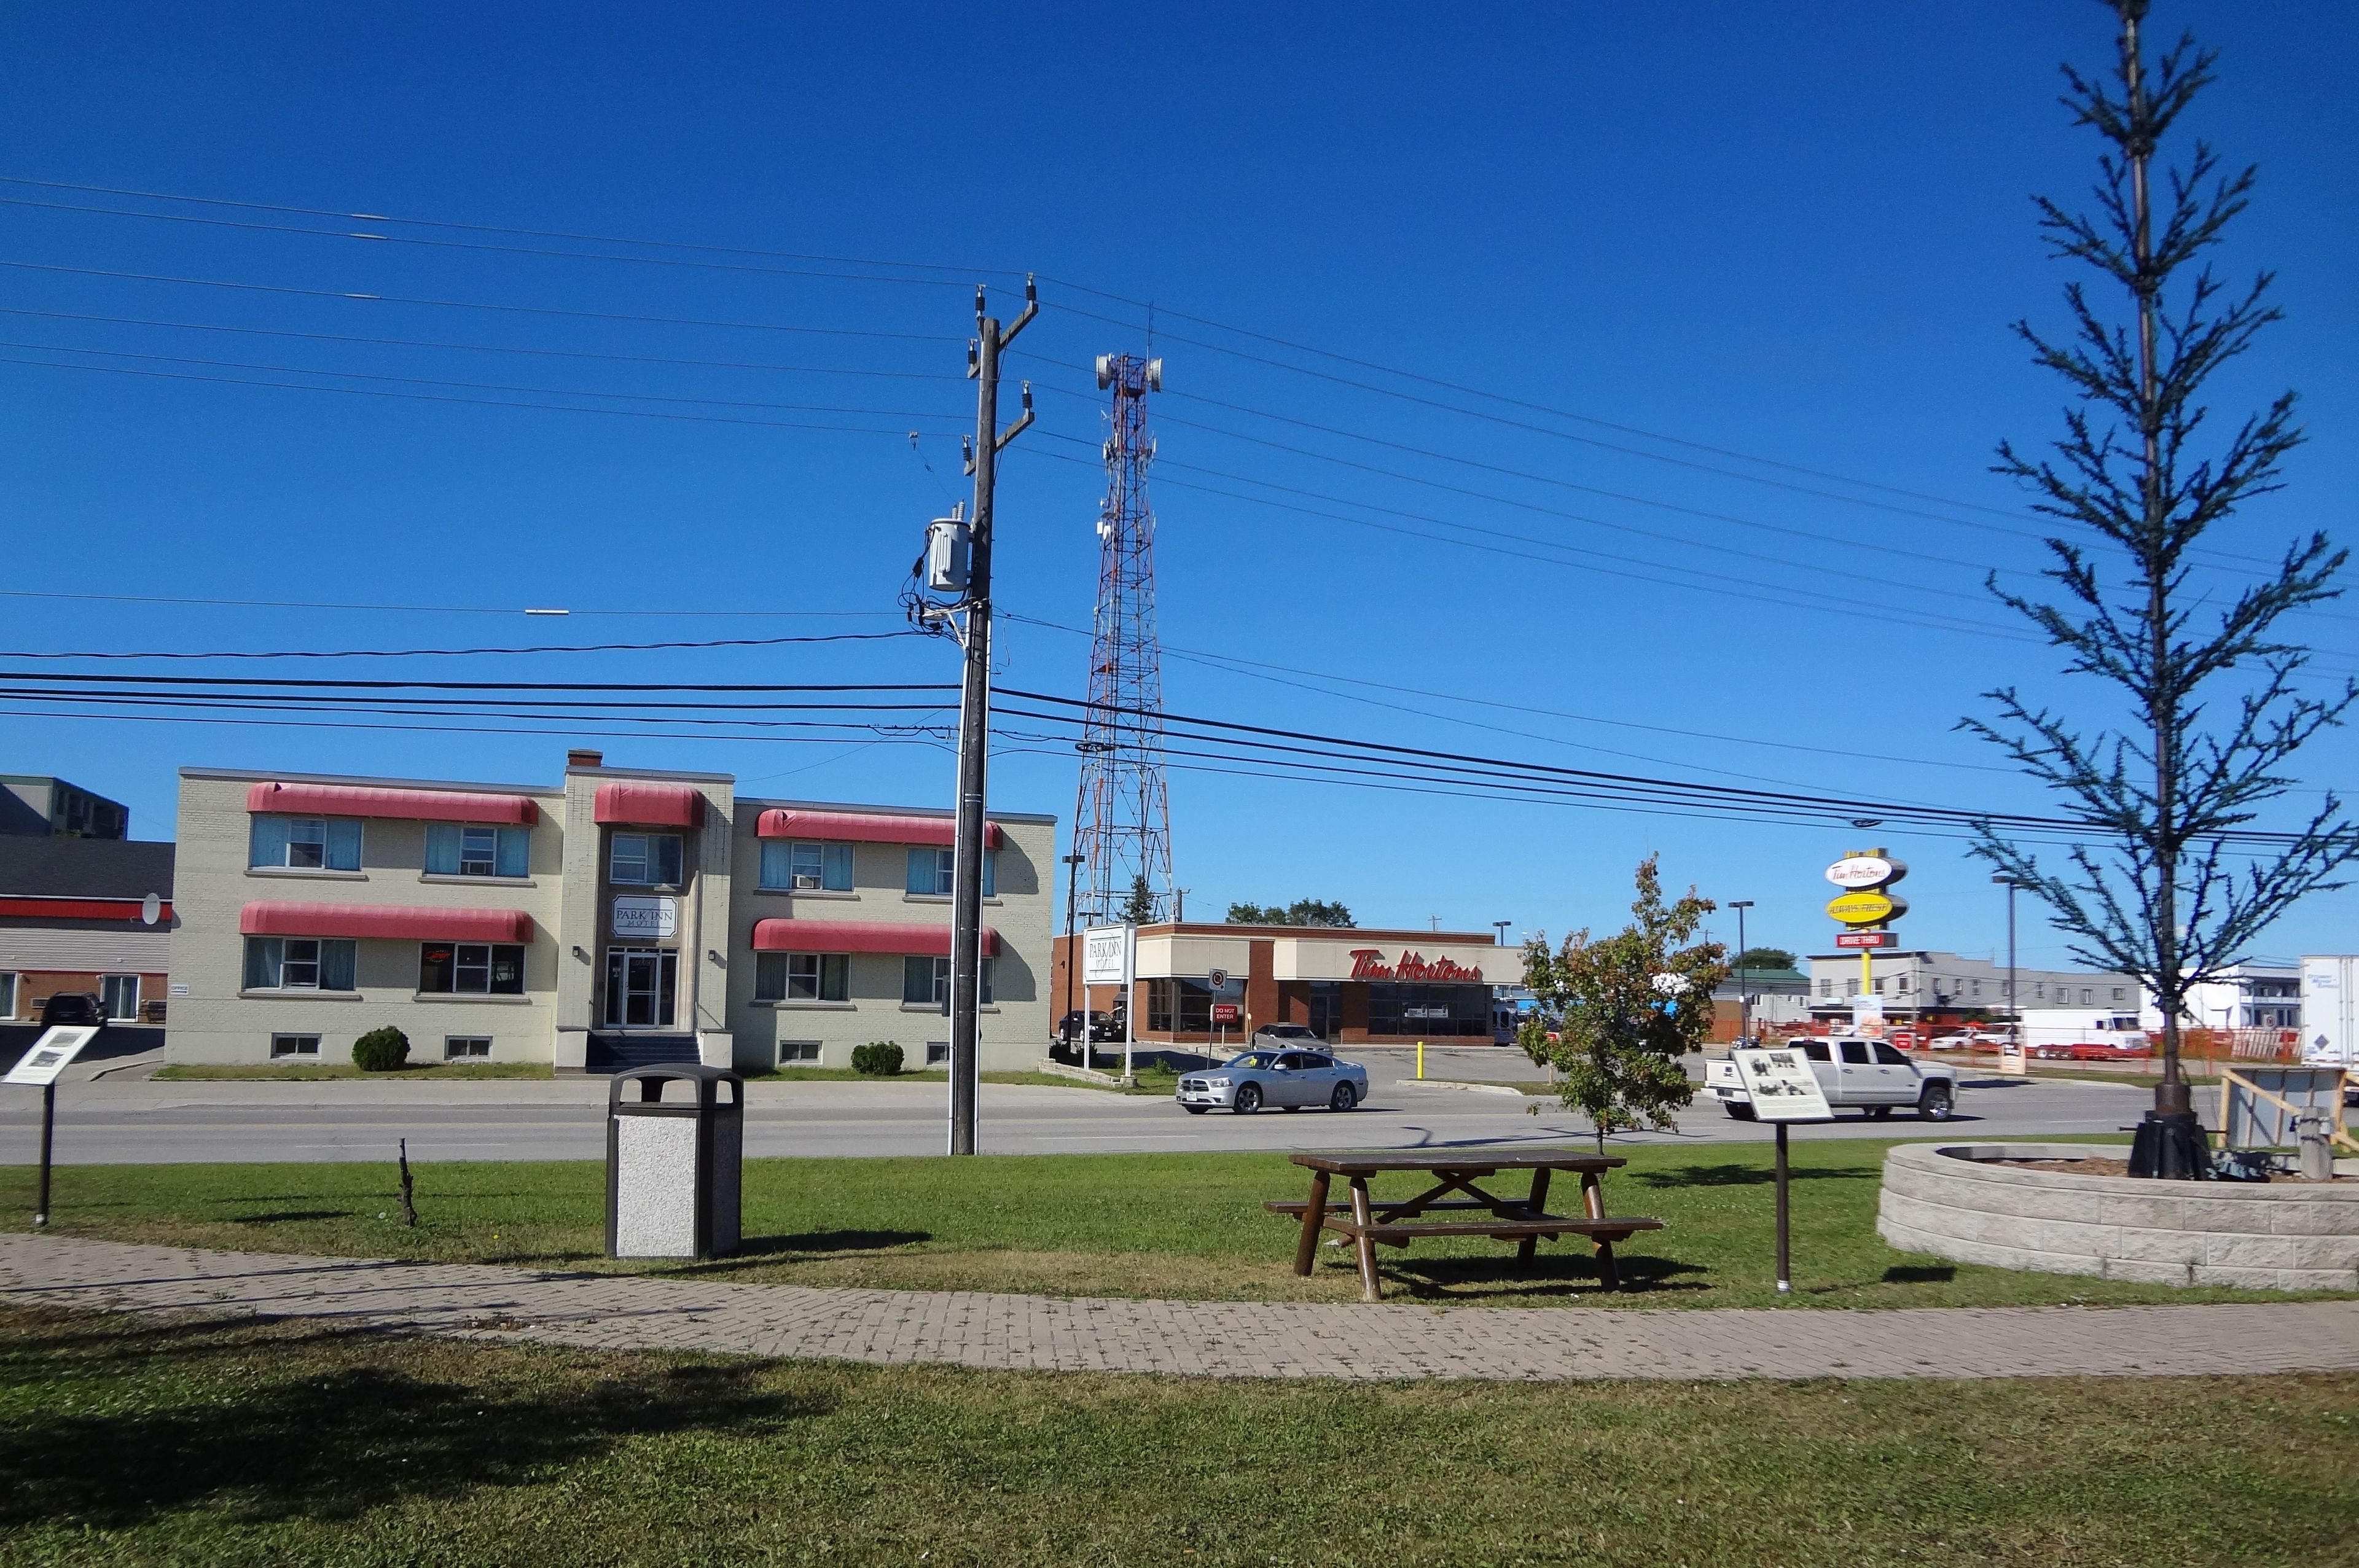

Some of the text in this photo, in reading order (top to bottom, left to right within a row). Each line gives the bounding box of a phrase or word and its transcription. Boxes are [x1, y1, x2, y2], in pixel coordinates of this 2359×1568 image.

[616, 910, 673, 921] PARK INN
[1089, 940, 1122, 958] PARK INN
[1095, 958, 1114, 969] MOTEL
[1348, 949, 1479, 981] Tim Hortons
